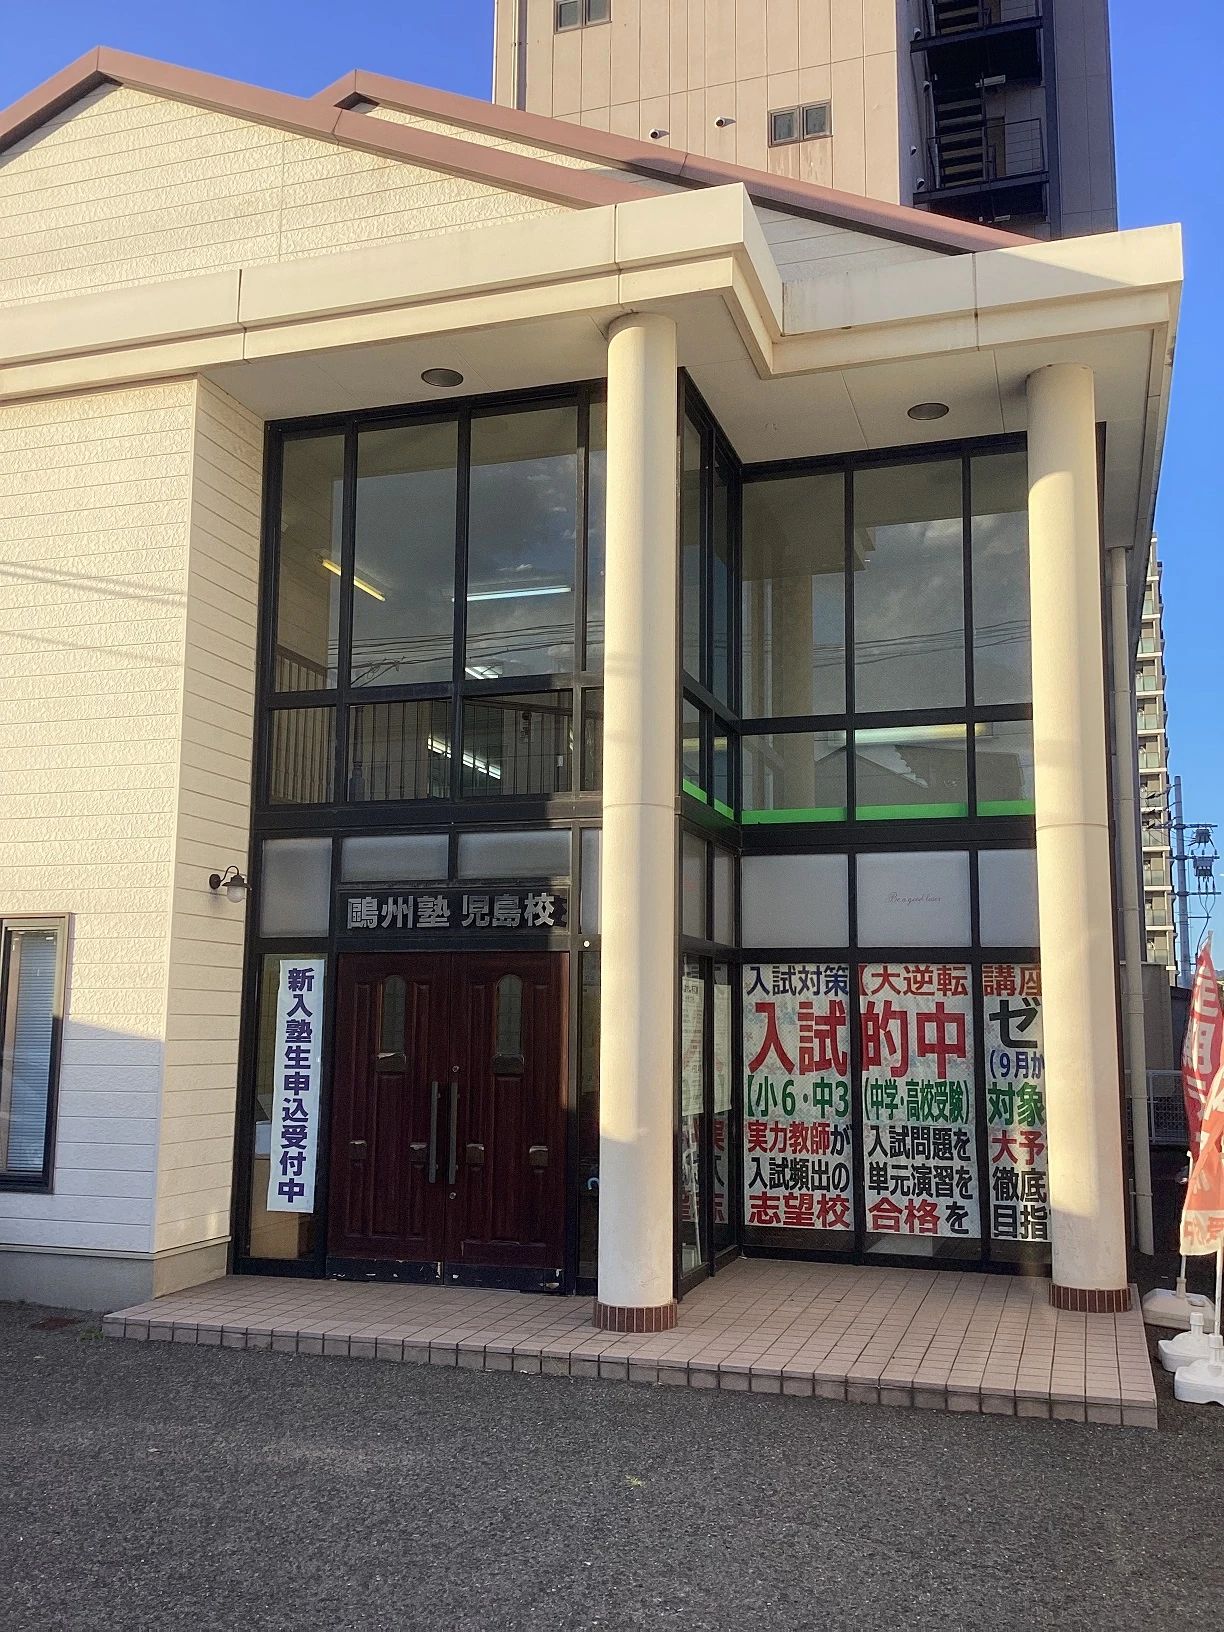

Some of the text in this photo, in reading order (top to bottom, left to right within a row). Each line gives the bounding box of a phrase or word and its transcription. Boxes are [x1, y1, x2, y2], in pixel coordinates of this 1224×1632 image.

[461, 892, 555, 928] 児島校
[747, 965, 1041, 996] 入試対策 【大逆転 講座
[749, 999, 848, 1076] 入試
[860, 999, 966, 1079] 的中
[989, 998, 1041, 1048] ゼ
[277, 967, 315, 1204] 新入塾生申込受付中
[988, 1081, 1045, 1127] 対象
[748, 1121, 1048, 1165] 実力教師が 入試問題を 大予
[748, 1158, 1047, 1203] 入試頻出の 単元演習を 徹底
[749, 1194, 1051, 1239] 志望校 合格を 目指
